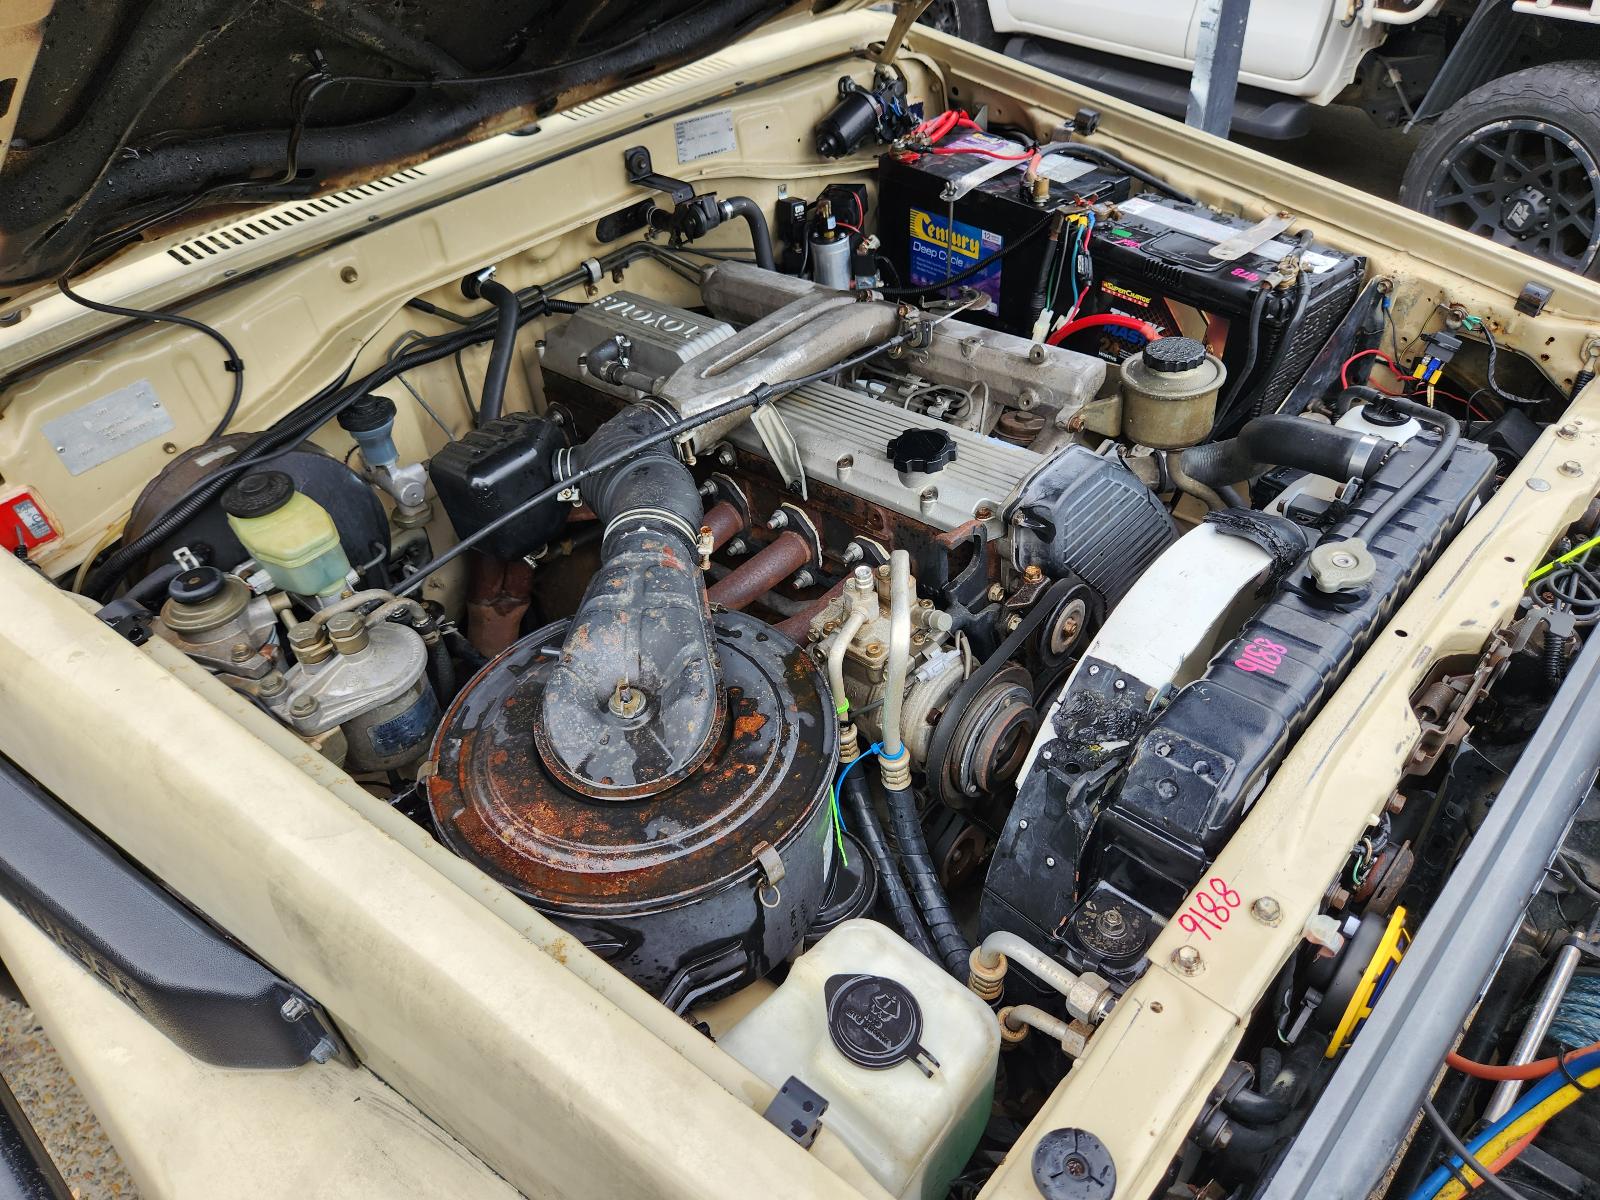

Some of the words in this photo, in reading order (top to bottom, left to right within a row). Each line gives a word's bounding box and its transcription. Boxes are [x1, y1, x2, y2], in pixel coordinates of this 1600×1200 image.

[913, 241, 937, 258] Deep
[938, 250, 964, 267] Ccle
[1234, 637, 1288, 674] 9188
[1178, 877, 1241, 941] 9188
